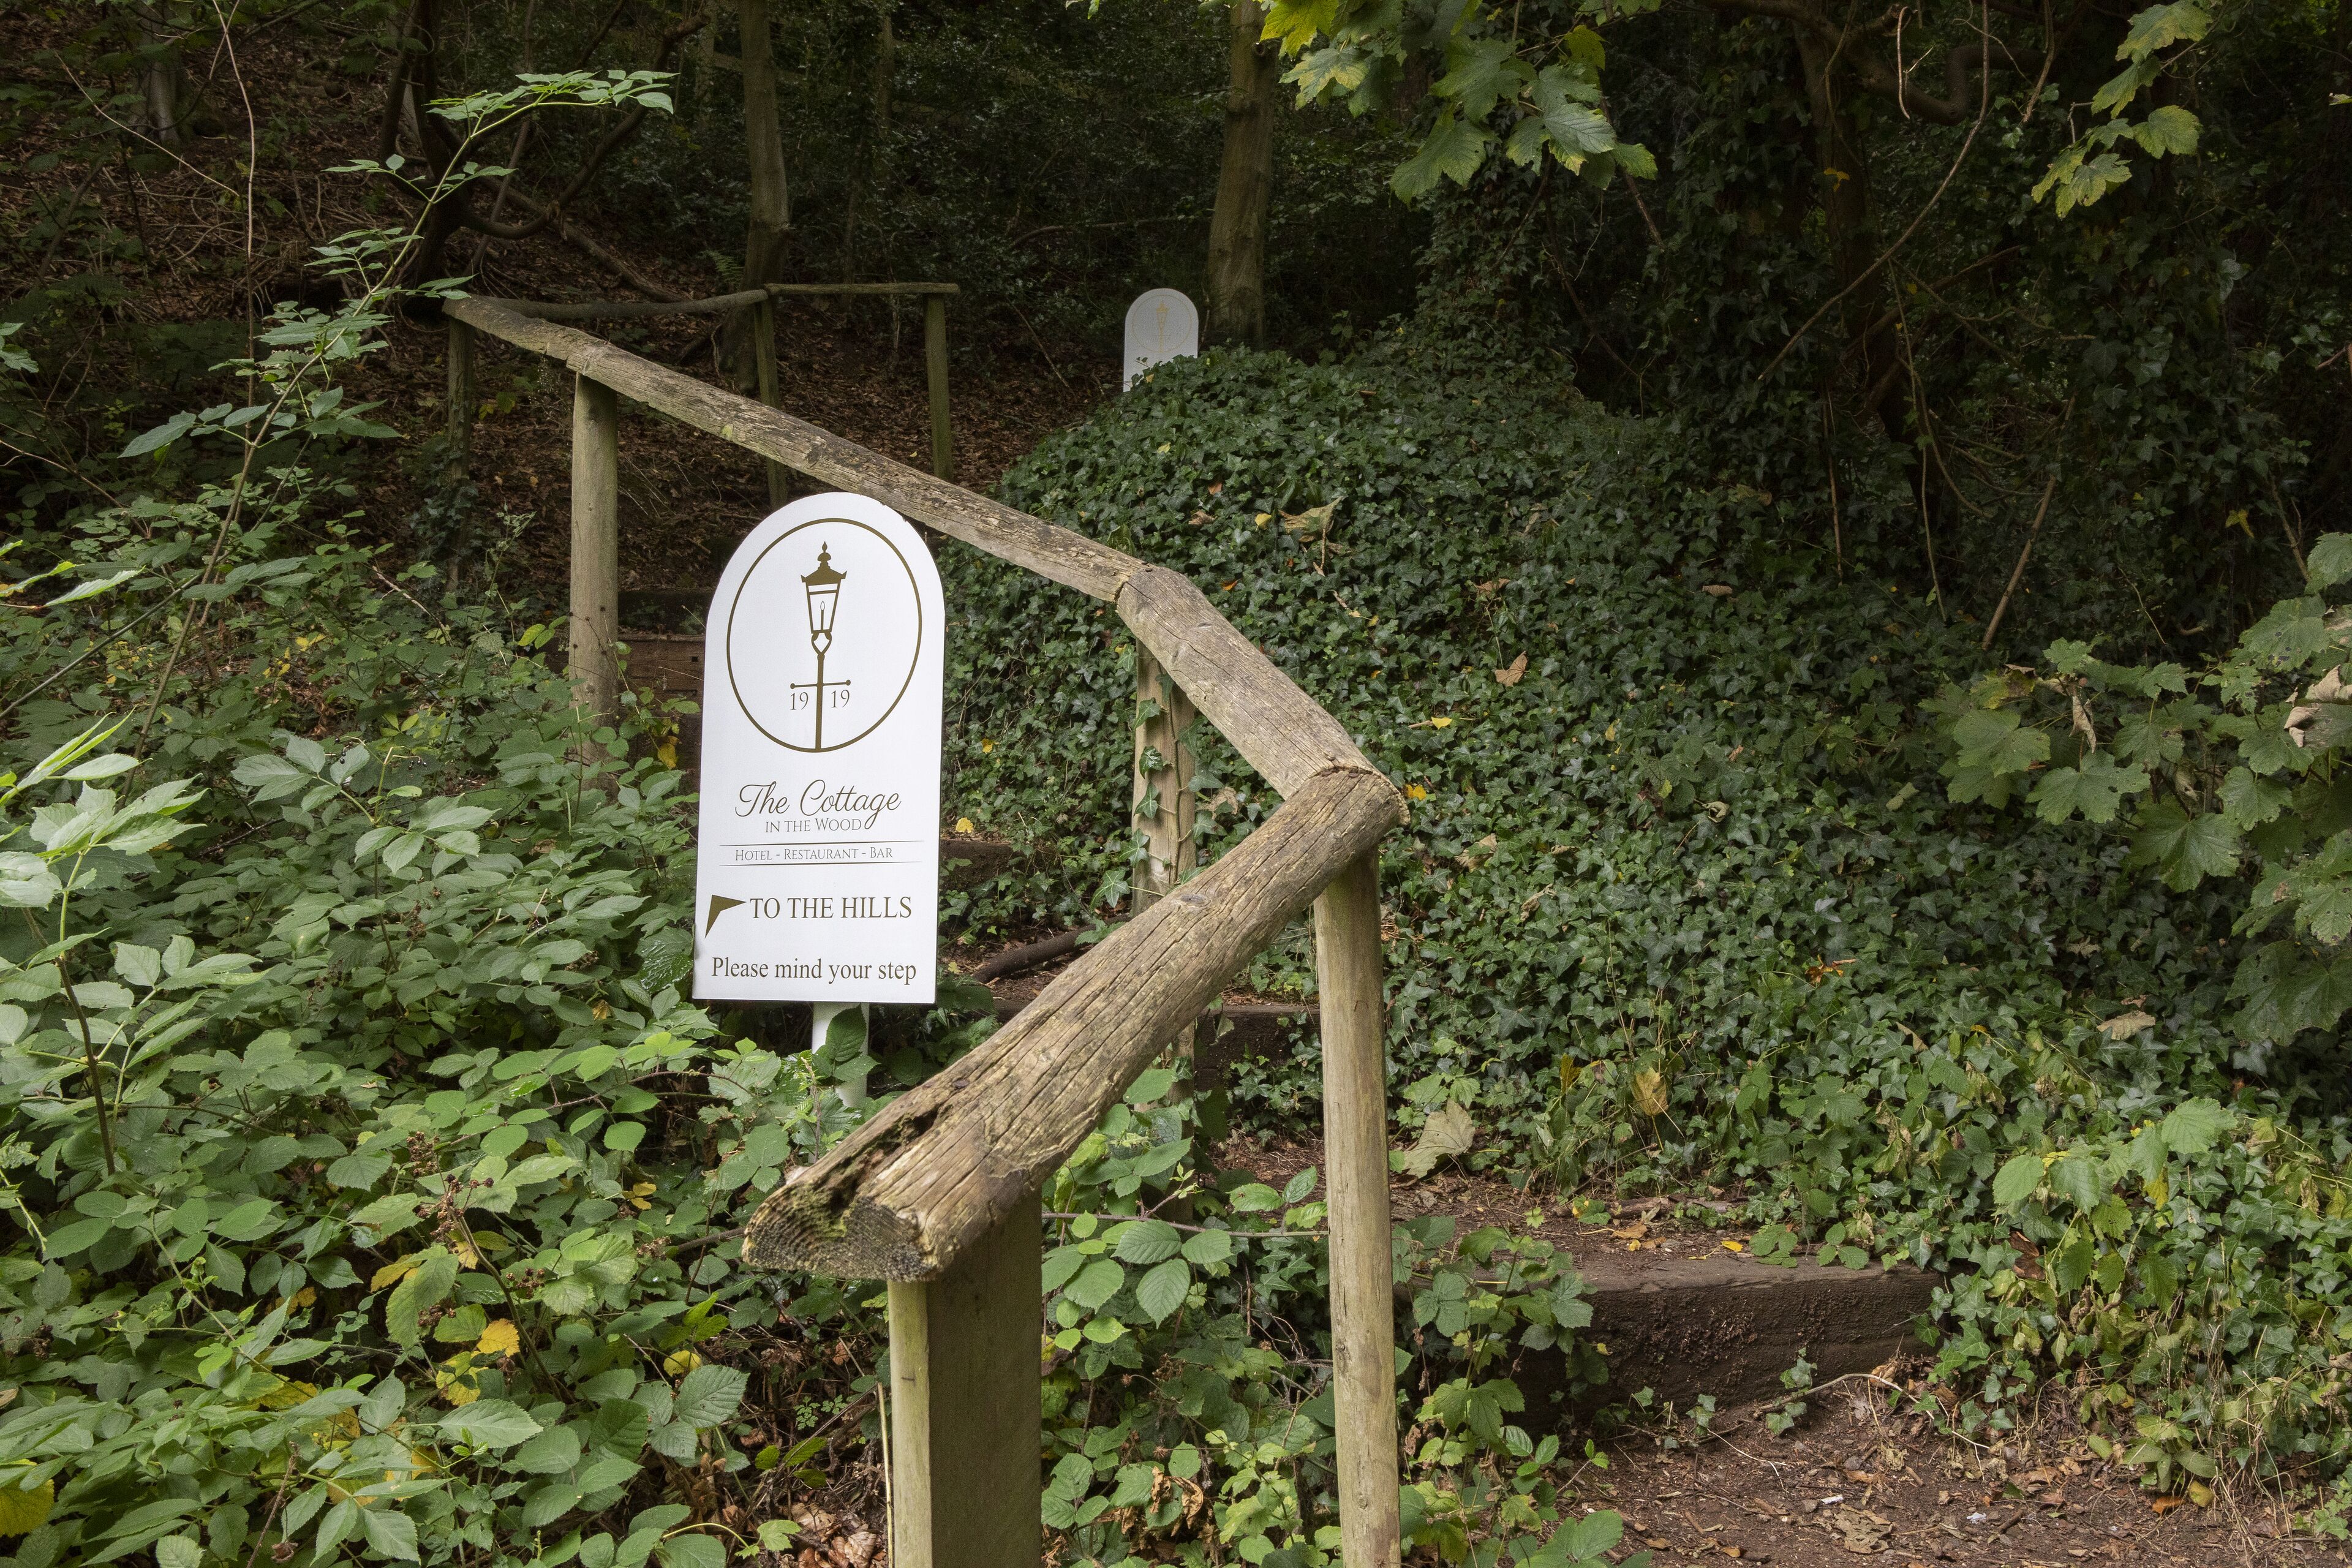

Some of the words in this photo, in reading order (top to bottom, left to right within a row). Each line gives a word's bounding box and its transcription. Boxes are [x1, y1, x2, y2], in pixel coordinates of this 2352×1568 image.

[790, 692, 809, 710] 19
[831, 689, 850, 708] 19
[735, 781, 790, 817] The
[800, 779, 902, 830] Cottage
[765, 821, 780, 833] IN
[784, 820, 811, 832] THE
[815, 818, 862, 832] WOOD
[735, 850, 772, 861] HOTEL
[784, 848, 859, 860] RESTAURANT
[870, 846, 893, 859] BAR
[750, 897, 780, 919] TO
[787, 897, 834, 919] THE
[841, 895, 912, 918] HILLS
[711, 957, 769, 978] Please
[774, 958, 823, 979] mind
[828, 965, 872, 985] your
[878, 962, 917, 986] step
